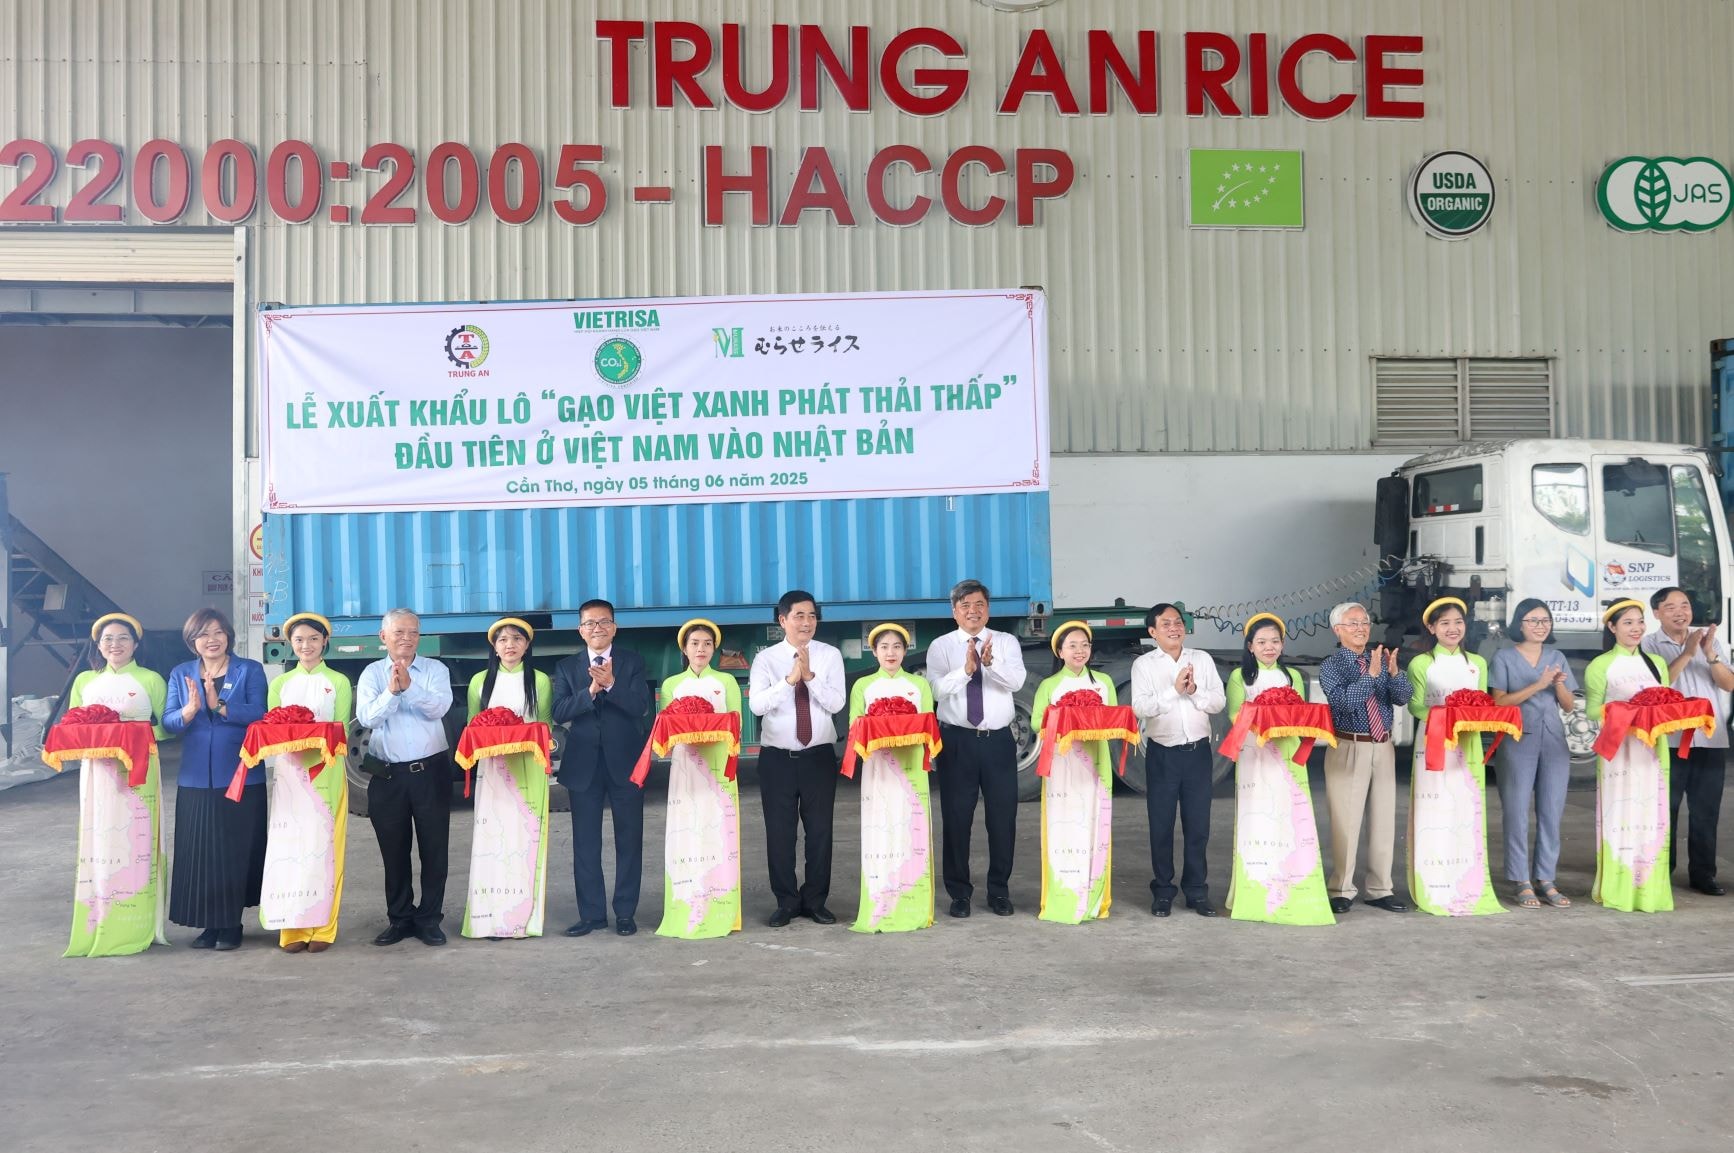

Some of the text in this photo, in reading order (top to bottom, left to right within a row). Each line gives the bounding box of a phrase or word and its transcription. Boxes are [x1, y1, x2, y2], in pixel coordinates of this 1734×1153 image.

[595, 20, 1425, 120] TRUNG AN RICE
[0, 139, 608, 226] 22000:2005
[704, 144, 1076, 228] HACCP
[1433, 172, 1477, 190] USDA
[1673, 183, 1723, 203] JAS
[1427, 196, 1483, 211] ORGANIC
[573, 309, 660, 329] VIETRISA
[754, 335, 860, 356] むらせライス
[447, 369, 490, 378] TRUNG AN
[286, 391, 318, 429] LỄ
[327, 390, 400, 429] XUẤT
[409, 388, 487, 427] KHẨU
[497, 392, 531, 425] LÔ
[623, 387, 683, 426] VIỆT
[693, 389, 769, 418] XANH
[778, 382, 851, 417] PHÁT
[858, 377, 922, 414] THẢI
[394, 419, 914, 470] ĐẦU TIÊN Ở VIỆT NAM VÀO NHẬT BẢN
[506, 471, 808, 494] Cần Thơ, ngày 05 tháng 06 năm 2025
[1627, 562, 1655, 573] SNP
